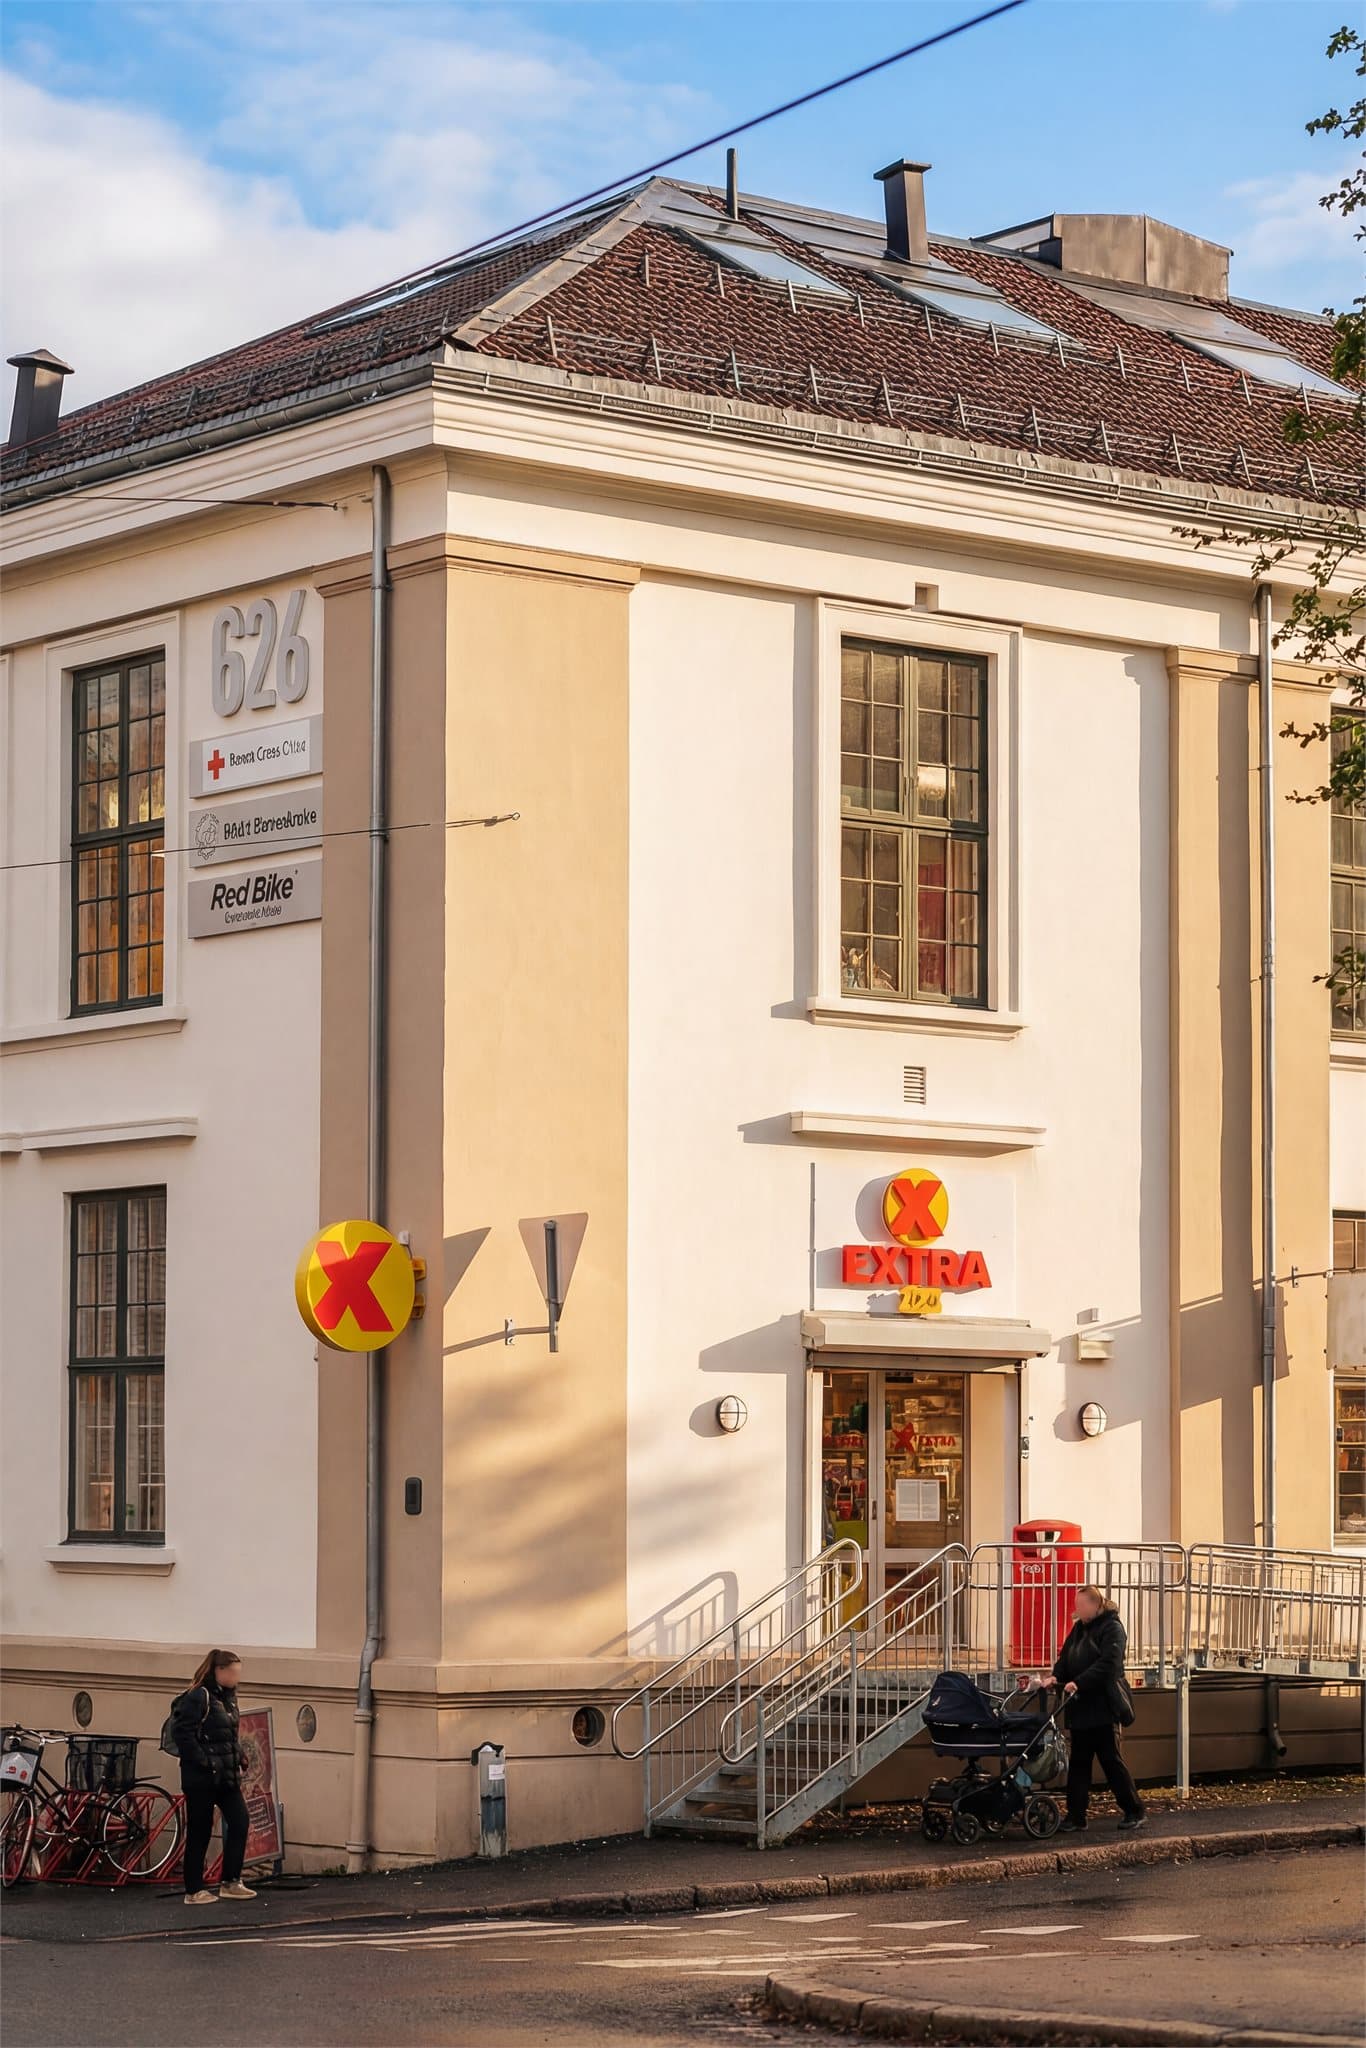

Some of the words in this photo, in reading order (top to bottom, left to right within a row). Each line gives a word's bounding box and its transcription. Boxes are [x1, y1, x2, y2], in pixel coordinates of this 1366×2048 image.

[212, 590, 309, 717] 626
[210, 877, 250, 911] Red
[251, 873, 294, 904] Bike
[889, 1178, 944, 1238] X
[313, 1241, 395, 1332] X
[842, 1244, 993, 1289] EXTRA
